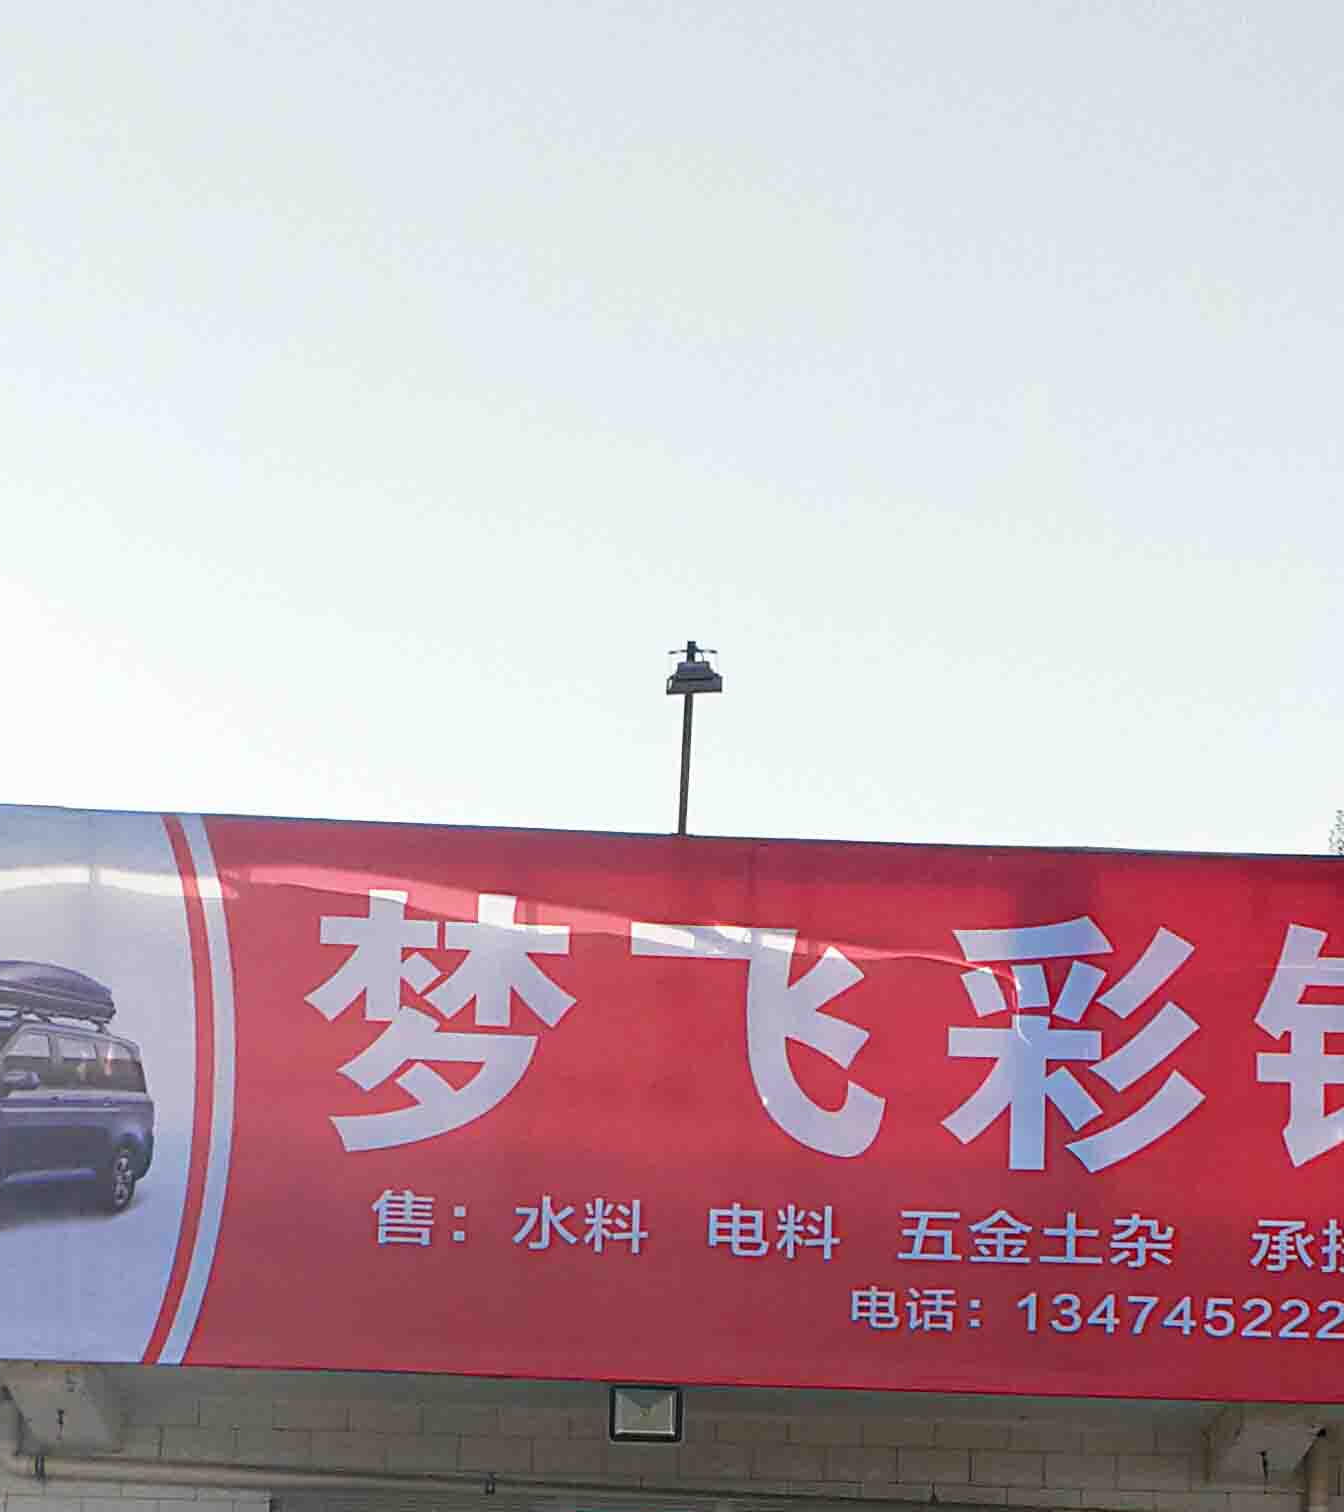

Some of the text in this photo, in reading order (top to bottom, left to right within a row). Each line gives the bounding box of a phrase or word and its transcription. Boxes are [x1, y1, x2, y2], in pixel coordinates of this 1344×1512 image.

[708, 1204, 842, 1262] 电料
[897, 1208, 1175, 1270] 五金土杂
